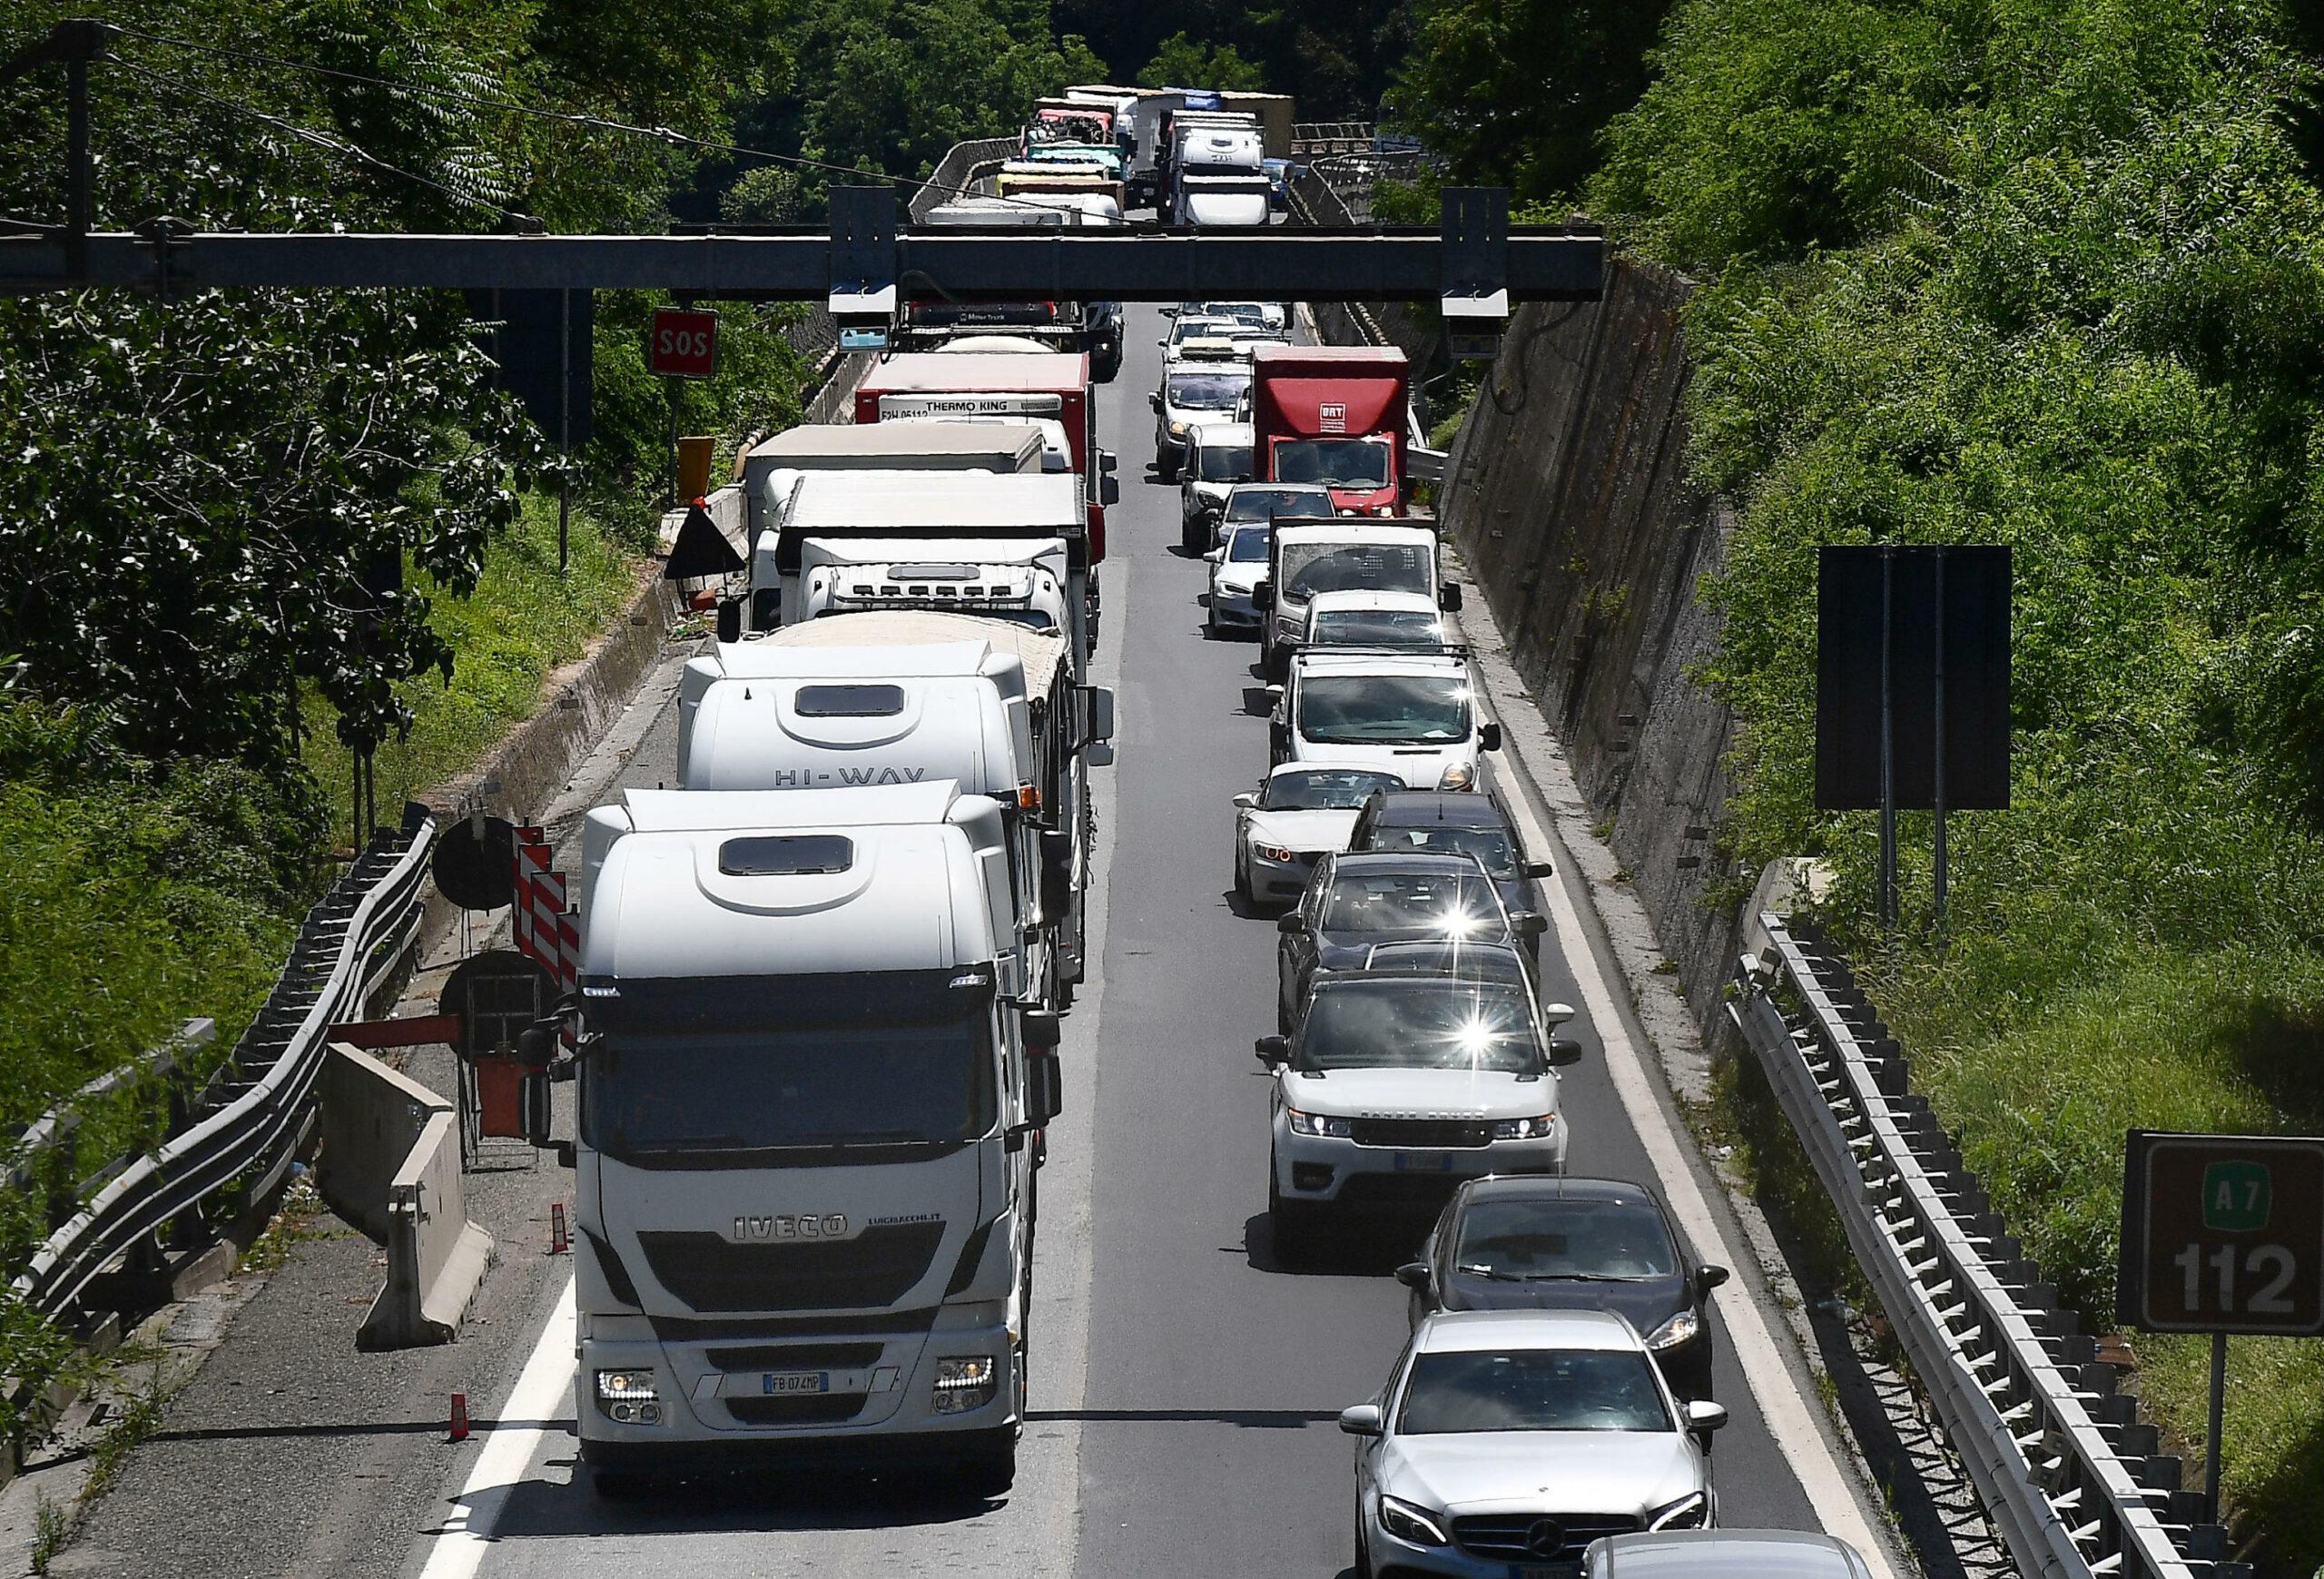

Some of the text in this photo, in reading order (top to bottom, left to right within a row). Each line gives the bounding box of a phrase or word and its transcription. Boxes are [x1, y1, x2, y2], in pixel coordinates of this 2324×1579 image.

[660, 330, 707, 357] SOS
[926, 401, 1007, 411] THERMO KING
[775, 767, 924, 785] HI-WAY
[2215, 1180, 2260, 1211] A 7
[734, 1214, 848, 1239] IVECO
[2174, 1243, 2296, 1312] 112
